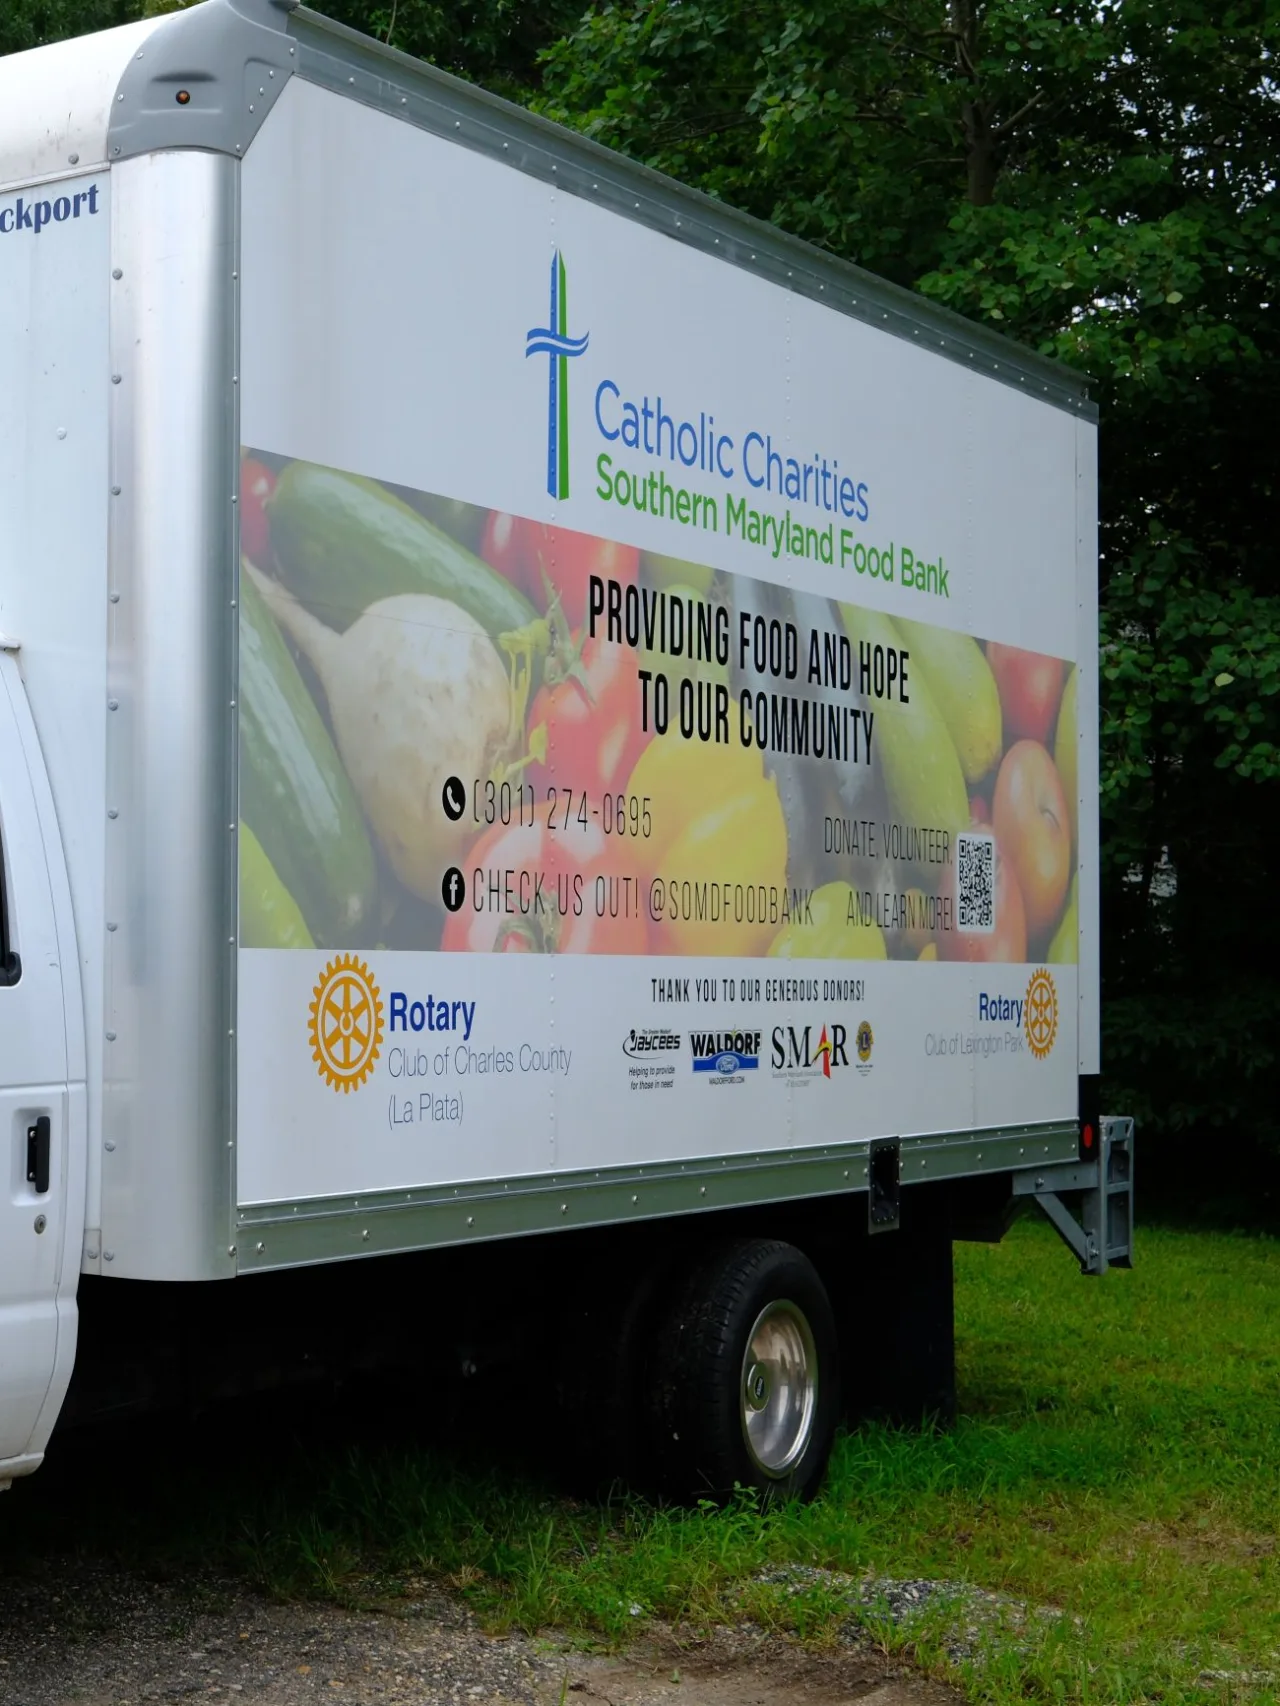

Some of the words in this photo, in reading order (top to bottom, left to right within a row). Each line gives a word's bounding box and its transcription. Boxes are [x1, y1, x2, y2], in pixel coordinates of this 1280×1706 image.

[595, 379, 734, 480] Catholic
[743, 431, 869, 523] Charities
[596, 453, 718, 533] Southern
[726, 493, 833, 566] Maryland
[841, 529, 894, 582] Food
[901, 547, 949, 599] Bank
[589, 575, 729, 666] PROVIDING
[740, 611, 798, 680] FOOD
[808, 629, 851, 691] AND
[859, 640, 909, 704] HOPE
[638, 670, 669, 736] TO
[680, 678, 729, 744] OUR
[739, 689, 874, 766] COMMUNITY
[473, 779, 535, 827] (301)
[547, 787, 652, 838] 274-0695
[473, 868, 545, 914] CHECK
[558, 873, 583, 917] US
[595, 875, 639, 919] OUT!
[649, 878, 814, 926] @SOMDFOODBANK
[847, 891, 872, 927] AND
[876, 892, 915, 930] LEARN
[919, 896, 953, 931] MORE!
[651, 978, 690, 1002] THANK
[695, 978, 717, 1002] YOU
[722, 979, 736, 1002] TO
[740, 979, 761, 1002] OUR
[765, 978, 819, 1002] GENEROUS
[823, 979, 865, 1002] DONORS!
[389, 991, 476, 1041] Rotary
[979, 993, 1023, 1028] Rotary
[388, 1047, 427, 1078] Club
[433, 1046, 450, 1076] of
[454, 1045, 514, 1075] Charles
[519, 1043, 572, 1076] County
[629, 1034, 681, 1051] Jaycees
[690, 1032, 761, 1057] WALDORF
[924, 1032, 947, 1056] Club
[949, 1032, 958, 1055] of
[1004, 1032, 1024, 1053] Park
[629, 1066, 648, 1078] Helping
[650, 1067, 655, 1076] to
[656, 1066, 675, 1077] provide
[639, 1080, 653, 1090] those
[655, 1080, 660, 1089] in
[661, 1079, 674, 1088] need
[388, 1093, 413, 1130] (La
[419, 1090, 464, 1125] Plata)
